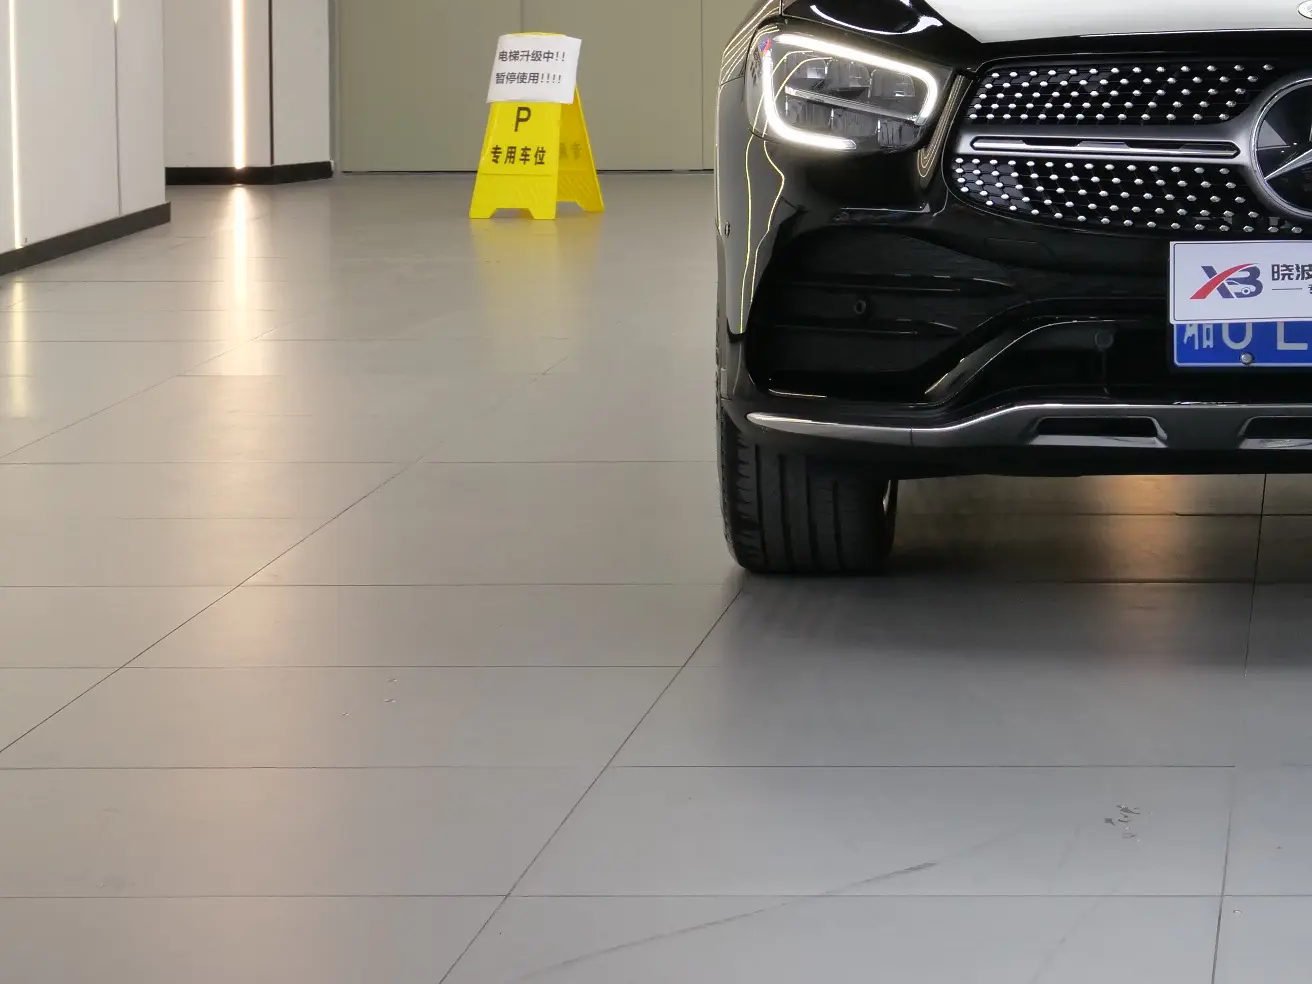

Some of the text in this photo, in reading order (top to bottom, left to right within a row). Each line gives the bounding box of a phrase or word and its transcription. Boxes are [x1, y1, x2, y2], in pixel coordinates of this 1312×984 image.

[498, 50, 565, 62] 电梯升级中!!
[495, 72, 562, 84] 暂停使用!!!!
[514, 106, 532, 132] P
[490, 144, 547, 166] 专用车位
